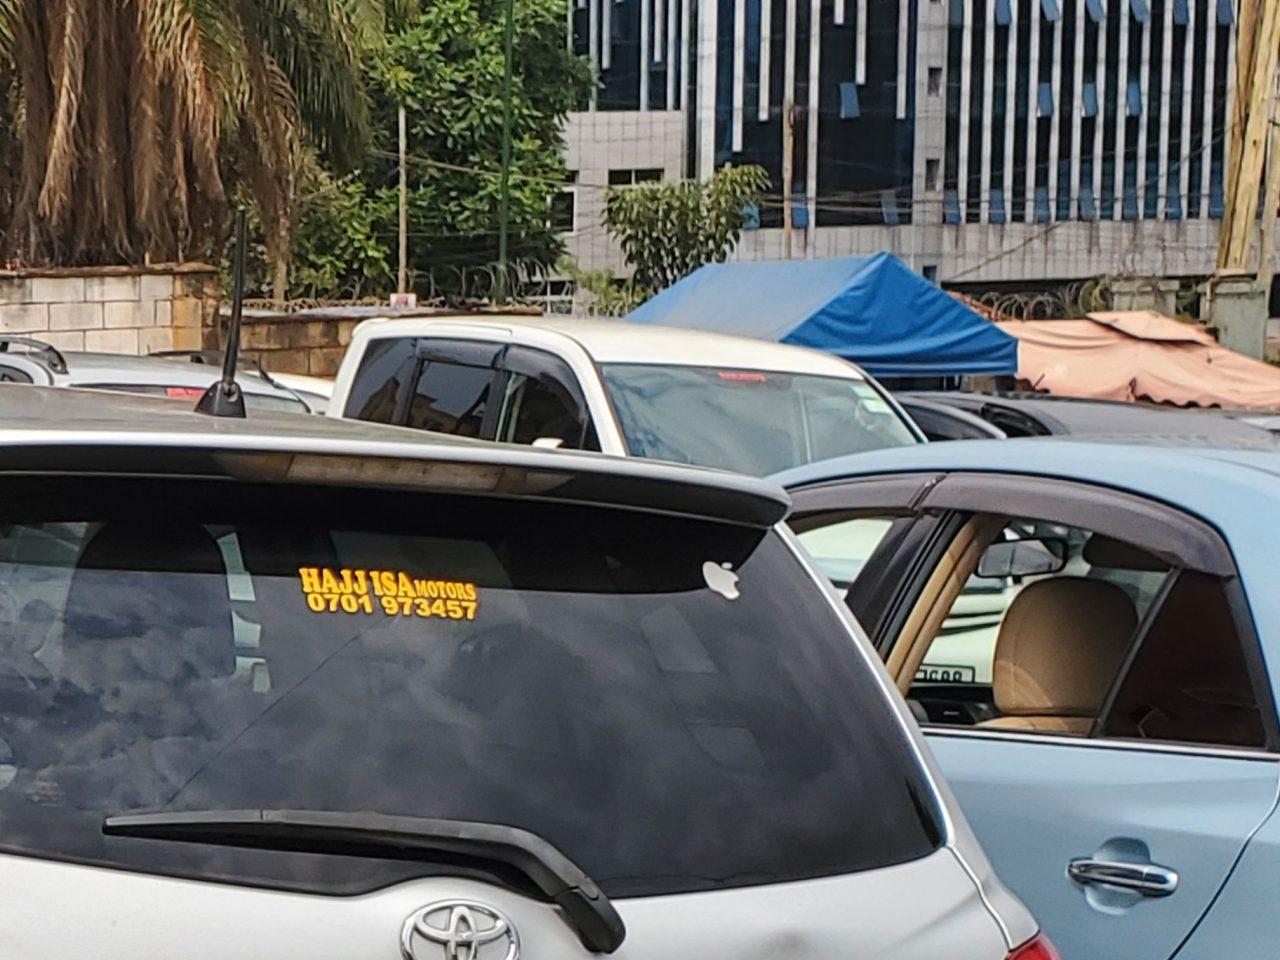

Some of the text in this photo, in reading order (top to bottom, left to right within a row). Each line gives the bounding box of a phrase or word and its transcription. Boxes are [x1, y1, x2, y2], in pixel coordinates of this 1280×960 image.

[299, 567, 478, 601] HAJJ ISA MOTORS
[307, 592, 478, 620] 0701 973457
